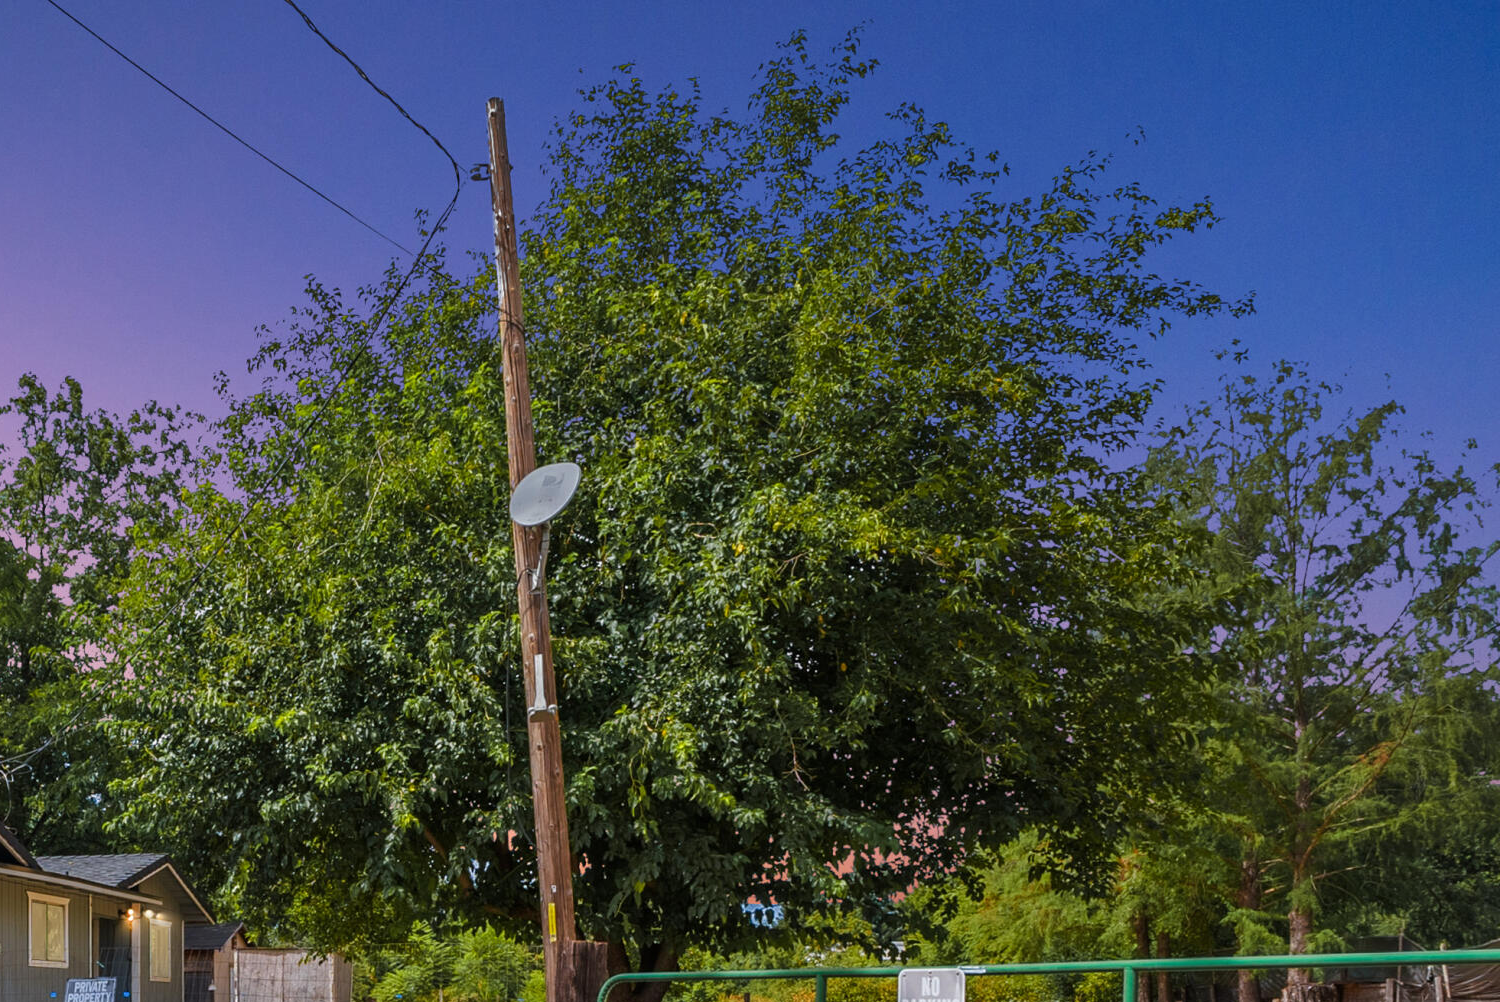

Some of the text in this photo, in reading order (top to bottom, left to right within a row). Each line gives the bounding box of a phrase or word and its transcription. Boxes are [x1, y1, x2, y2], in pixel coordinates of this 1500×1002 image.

[74, 981, 108, 993] PRIVATE
[921, 976, 940, 997] NO
[67, 992, 111, 1002] PROPERTY
